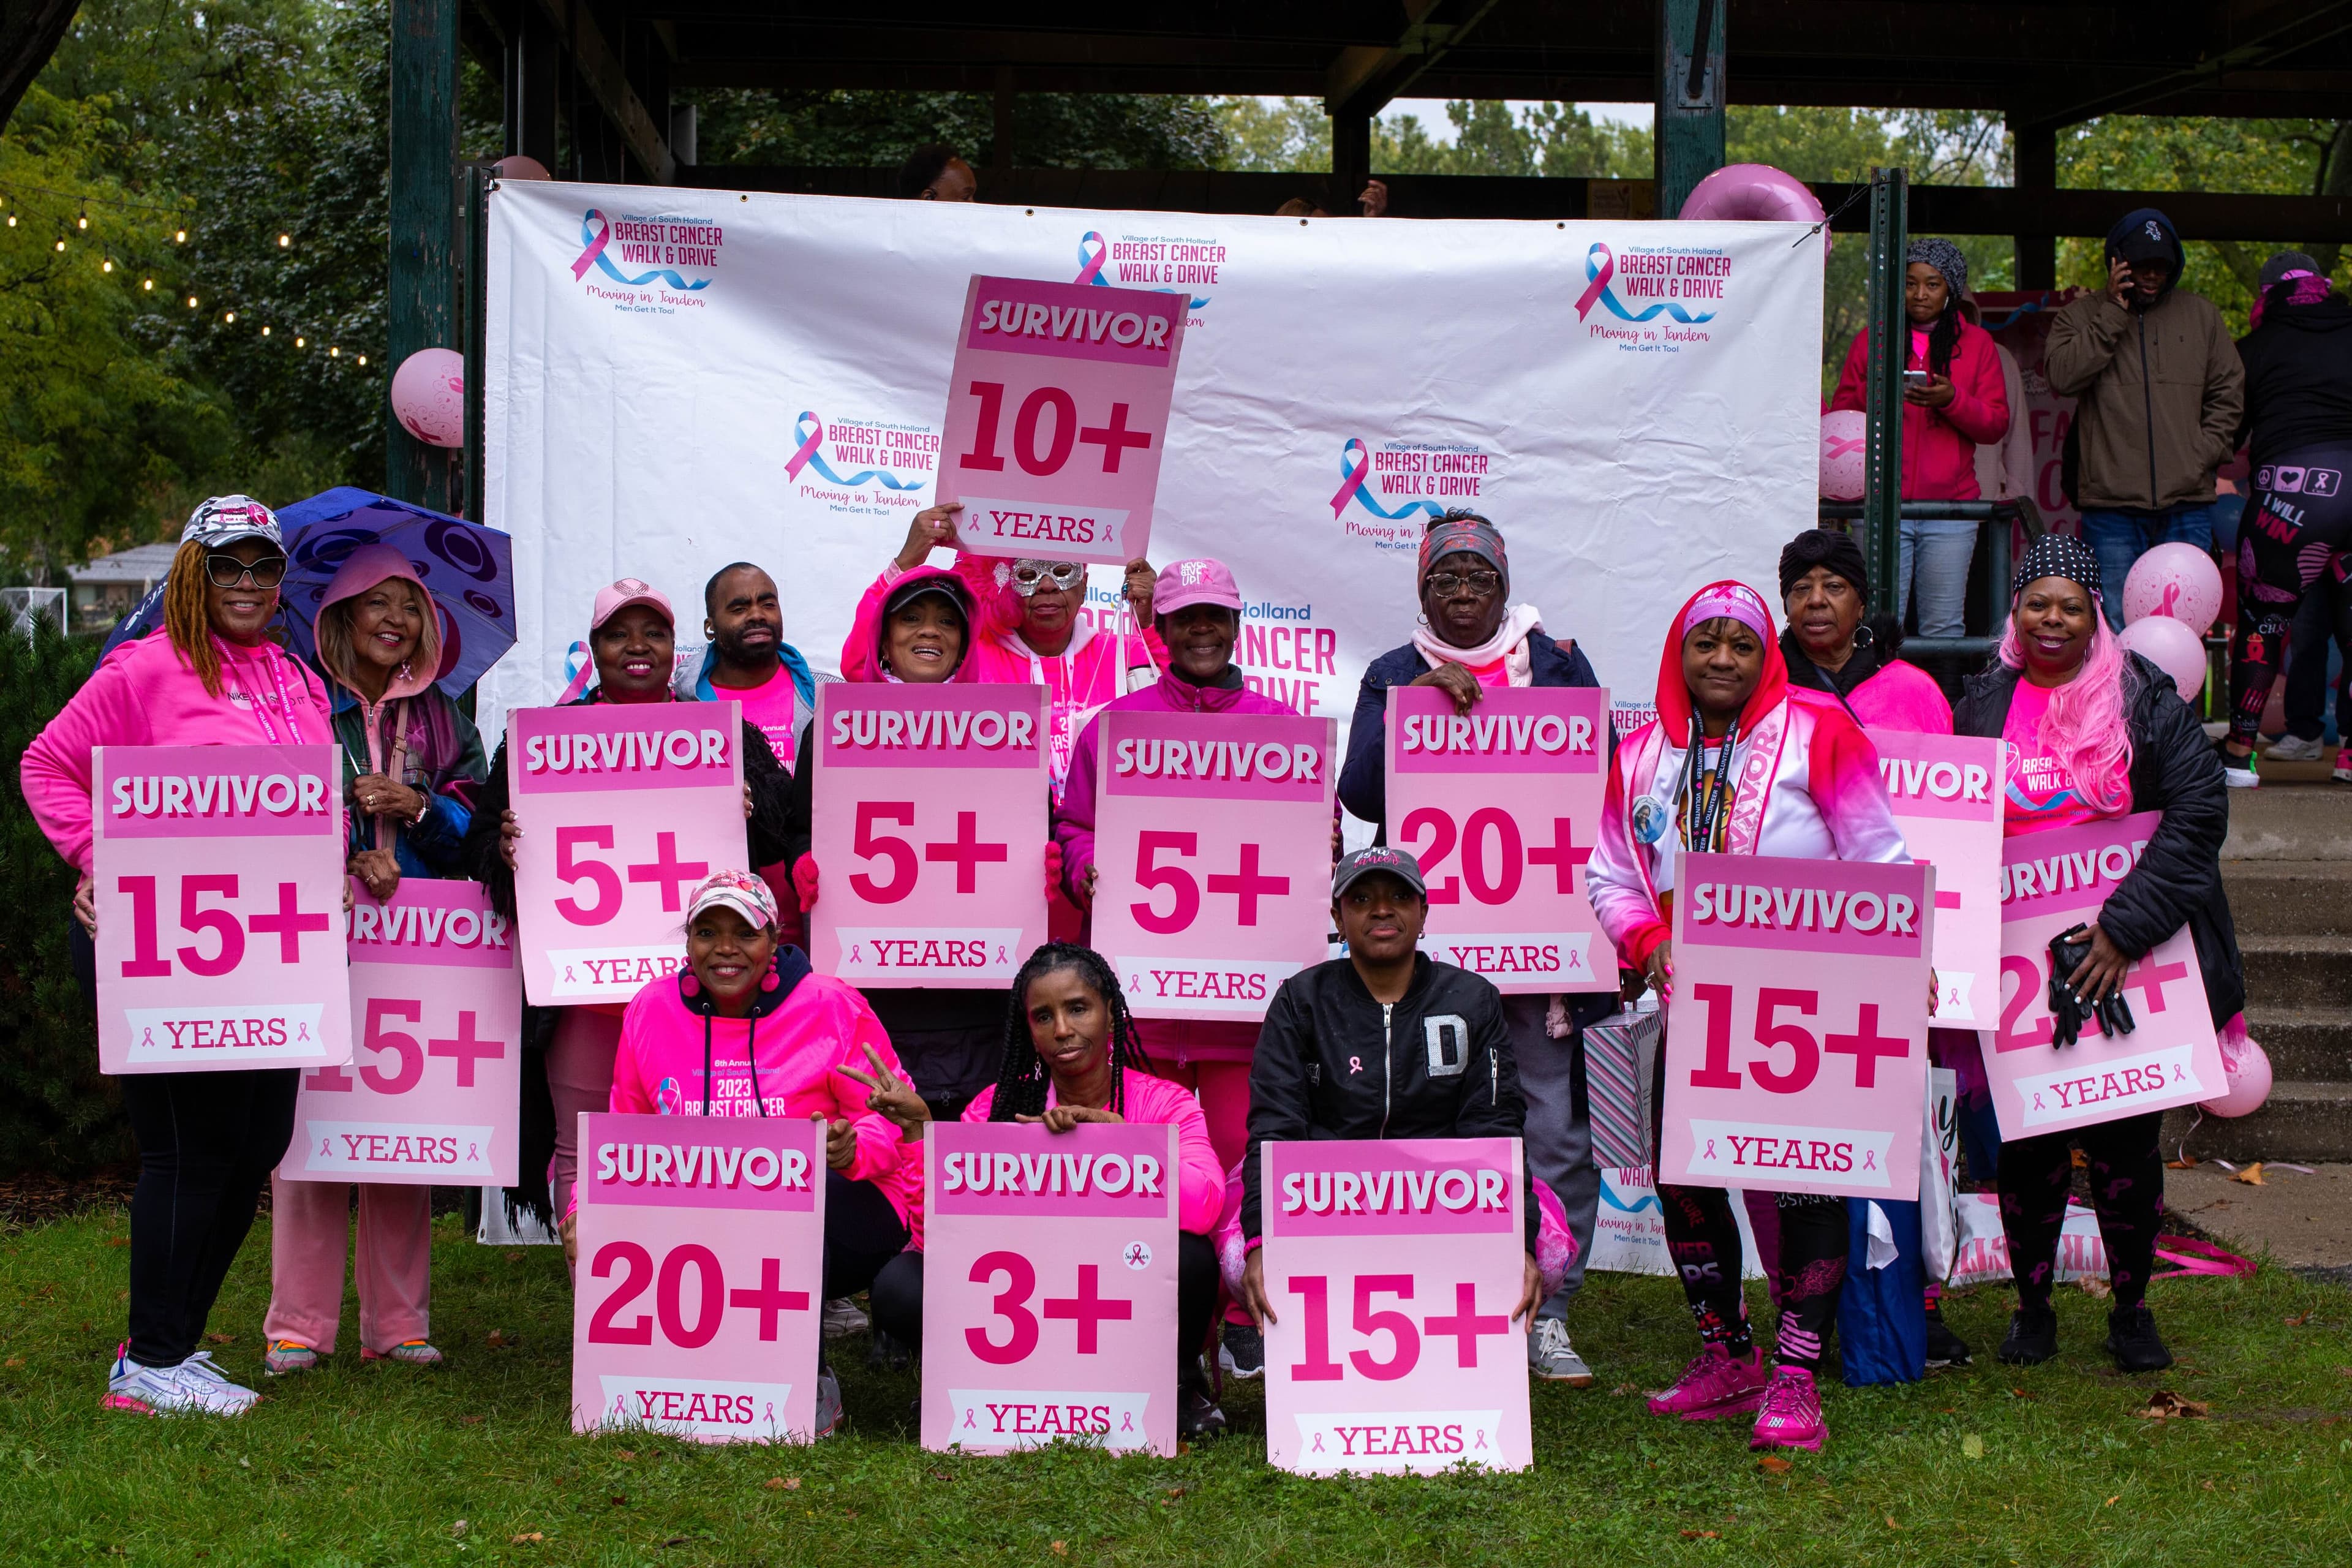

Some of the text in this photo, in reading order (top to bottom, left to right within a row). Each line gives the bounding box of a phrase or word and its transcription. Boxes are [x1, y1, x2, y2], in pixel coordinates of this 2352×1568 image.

[615, 222, 723, 246] BREAST CANCER
[622, 214, 643, 224] Village
[1113, 243, 1226, 263] BREAST CANCER
[1122, 235, 1148, 244] Village
[1628, 246, 1655, 255] Village
[622, 244, 717, 266] WALK & DRIVE
[1620, 254, 1731, 276] BREAST CANCER
[1119, 263, 1218, 284] WALK & DRIVE
[1626, 277, 1724, 298] WALK & DRIVE
[587, 285, 706, 307] Moving in Tandem
[979, 300, 1170, 348] SURVIVOR
[1590, 325, 1710, 344] Moving in Tandem
[829, 424, 940, 453] BREAST CANCER
[837, 417, 863, 427] Village
[900, 424, 930, 432] Holland
[960, 381, 1152, 476] 10+
[835, 445, 933, 470] WALK & DRIVE
[1376, 451, 1488, 474] BREAST CANCER
[1384, 443, 1411, 452] Village
[801, 485, 921, 507] Moving in Tandem
[1381, 475, 1480, 496] WALK & DRIVE
[2263, 492, 2305, 527] I WILL
[990, 511, 1095, 543] YEARS
[1346, 522, 1395, 541] Moving
[1400, 525, 1414, 538] in
[2255, 507, 2299, 545] WIN
[1234, 624, 1336, 676] NCER
[227, 692, 250, 701] NIKE
[279, 684, 292, 714] VOLUNTEER
[1615, 701, 1641, 710] Village
[258, 710, 276, 741] VOLUNTEER
[290, 722, 303, 745] OLUNTEER
[832, 710, 1034, 747] SURVIVOR
[1403, 715, 1594, 752] SURVIVOR
[526, 729, 726, 772] SURVIVOR
[1116, 739, 1319, 781] SURVIVOR
[1717, 744, 1730, 778] VOLUNTEER
[113, 774, 325, 816] SURVIVOR
[2027, 772, 2061, 792] WALK
[1705, 790, 1718, 824] VOLUNTEER
[849, 801, 1007, 904] 5+
[1400, 807, 1594, 905] 20+
[554, 824, 709, 926] 5+
[1130, 831, 1290, 933] 5+
[2002, 840, 2149, 902] RVIVO
[1693, 883, 1915, 933] SURVIVOR
[118, 873, 330, 978] 15+
[344, 904, 507, 946] RVIVOR
[870, 940, 987, 967] YEARS
[1449, 945, 1560, 972] YEARS
[583, 957, 687, 984] YEAR
[1150, 970, 1266, 1000] YEARS
[163, 1017, 287, 1050] YEARS
[1423, 1014, 1469, 1077] D
[1691, 983, 1909, 1093] 15+
[717, 1079, 751, 1098] 2023
[2049, 1063, 2165, 1110] YEARS
[685, 1100, 731, 1117] BRAST
[341, 1134, 457, 1163] YEARS
[1727, 1136, 1852, 1172] YEARS
[597, 1144, 808, 1188] SURVIVOR
[944, 1152, 1161, 1194] SURVIVOR
[1619, 1167, 1653, 1188] WALK
[1283, 1169, 1506, 1212] SURVIVOR
[1636, 1219, 1645, 1233] in
[588, 1241, 809, 1348] 20+
[965, 1251, 1132, 1365] 3+
[1289, 1274, 1509, 1381] 15+
[636, 1390, 753, 1424] YEARS
[986, 1404, 1110, 1434] YEARS
[1334, 1425, 1464, 1455] YEARS
